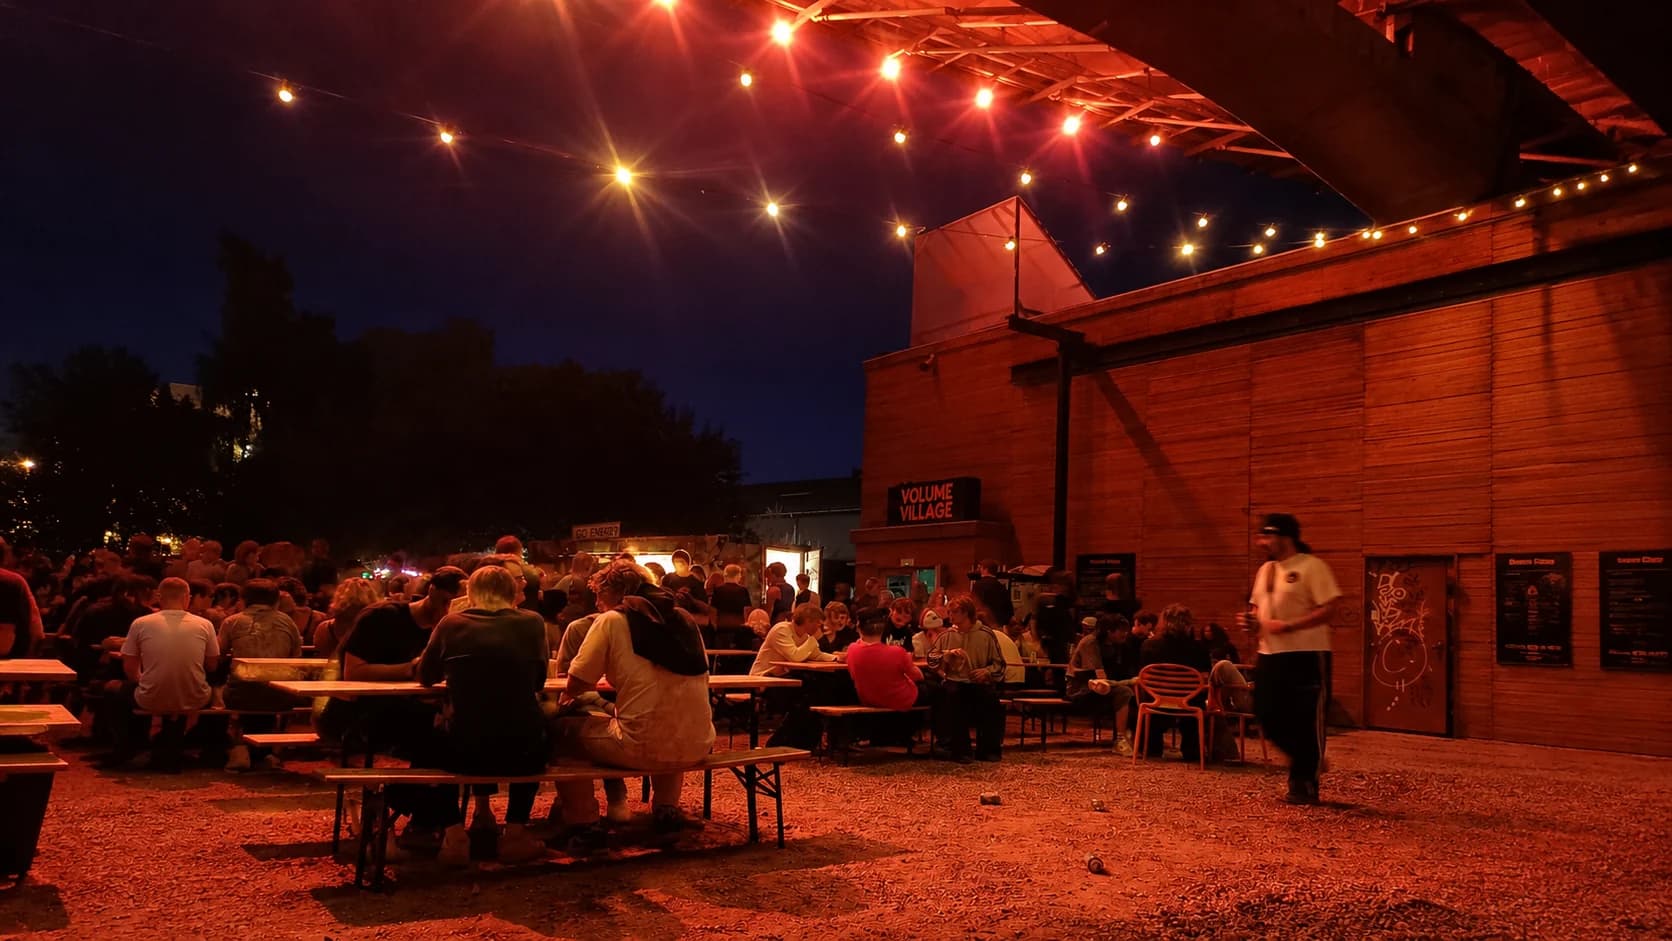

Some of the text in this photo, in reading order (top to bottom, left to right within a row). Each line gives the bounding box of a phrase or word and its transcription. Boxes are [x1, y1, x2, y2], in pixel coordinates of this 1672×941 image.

[901, 483, 954, 504] VOLUME
[900, 501, 953, 521] VILLAGE
[575, 528, 587, 539] GO
